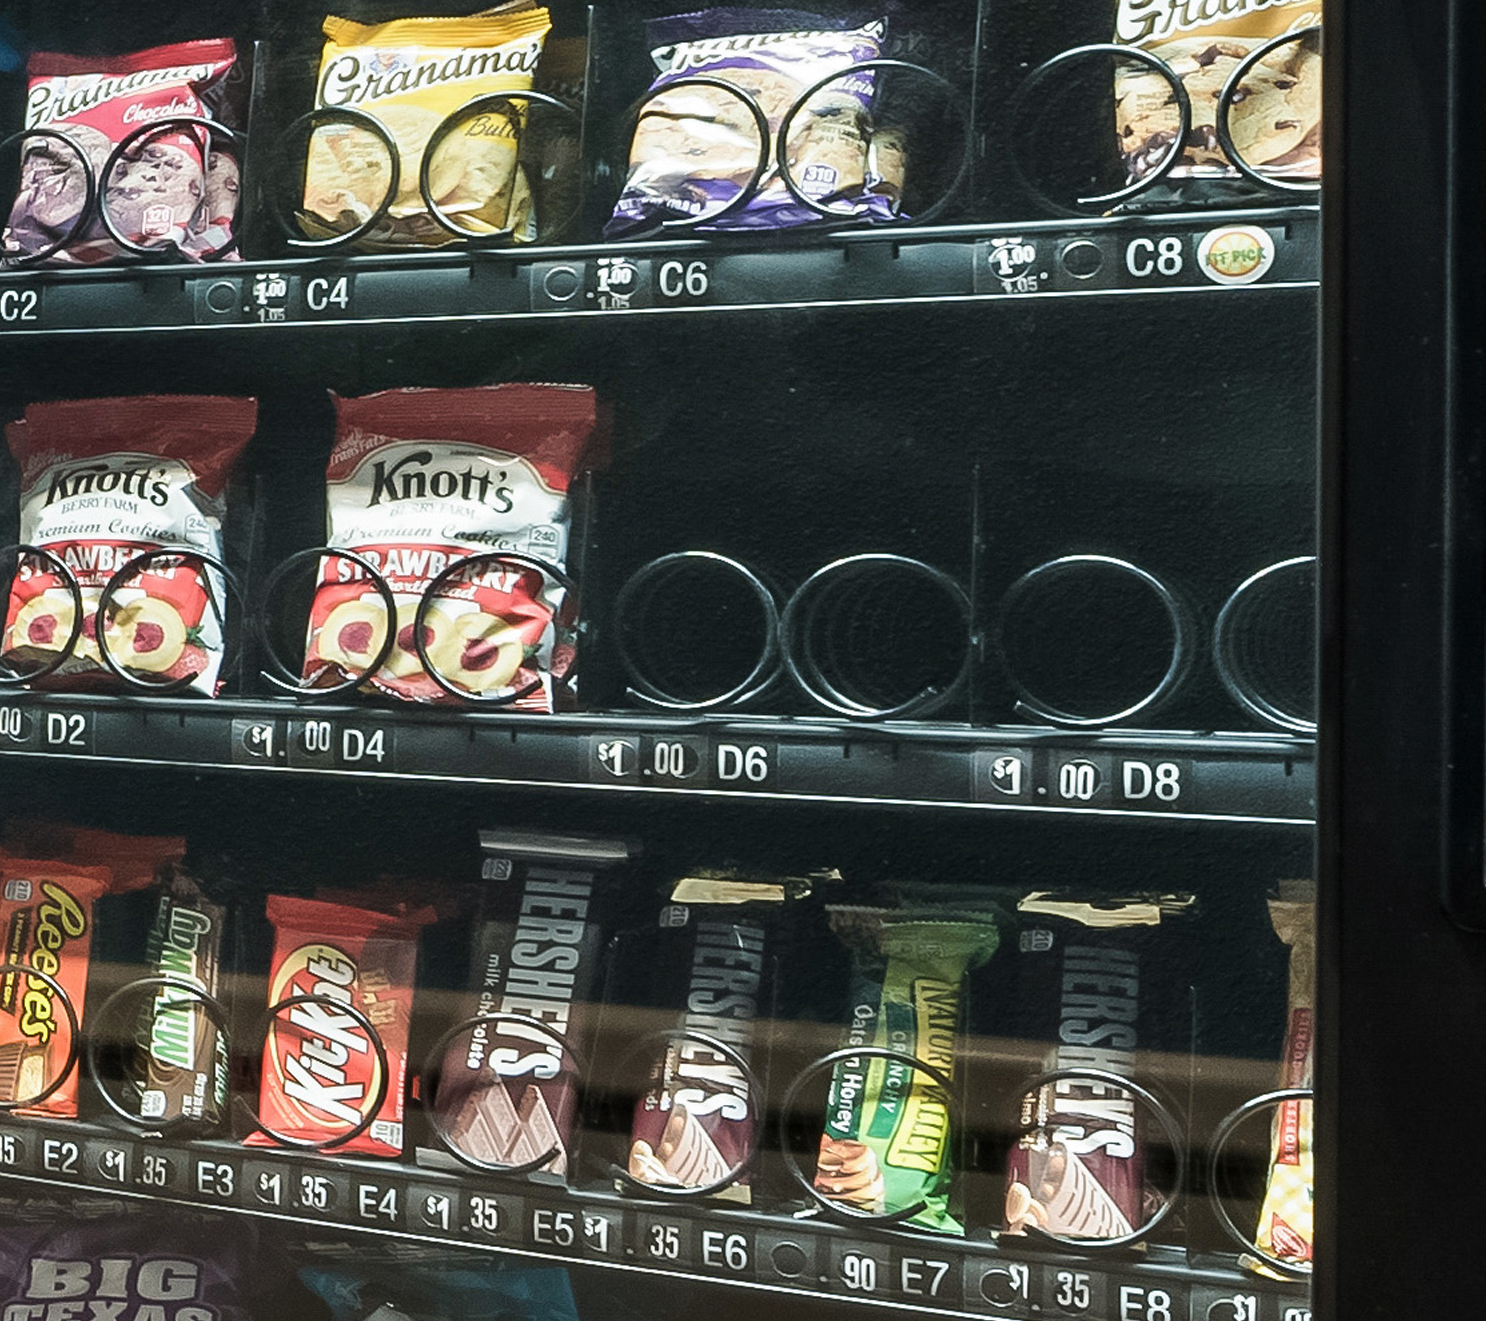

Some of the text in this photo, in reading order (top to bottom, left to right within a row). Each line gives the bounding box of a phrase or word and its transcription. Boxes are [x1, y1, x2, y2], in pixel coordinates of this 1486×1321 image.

[319, 44, 540, 107] Grandma's
[122, 97, 198, 123] Chocolate
[1126, 236, 1183, 277] C8
[306, 277, 349, 310] C4
[659, 261, 708, 297] C6
[0, 290, 38, 321] C2
[43, 466, 169, 508] Knott's
[367, 451, 514, 514] Knott's
[103, 497, 140, 514] FARM
[108, 518, 177, 541] Cookies
[47, 713, 87, 746] D2
[343, 730, 386, 763] D4
[717, 744, 768, 781] D6
[1123, 761, 1181, 801] D8
[21, 882, 86, 1043] Reese's
[489, 867, 594, 1080] HERSHEY'S
[830, 1073, 863, 1132] Honey
[43, 1141, 79, 1175] E2
[197, 1163, 234, 1197] E3
[359, 1185, 399, 1221] E4
[533, 1210, 575, 1246] E5
[702, 1232, 748, 1271] E6
[28, 1259, 202, 1301] BIG
[902, 1258, 951, 1297] E7
